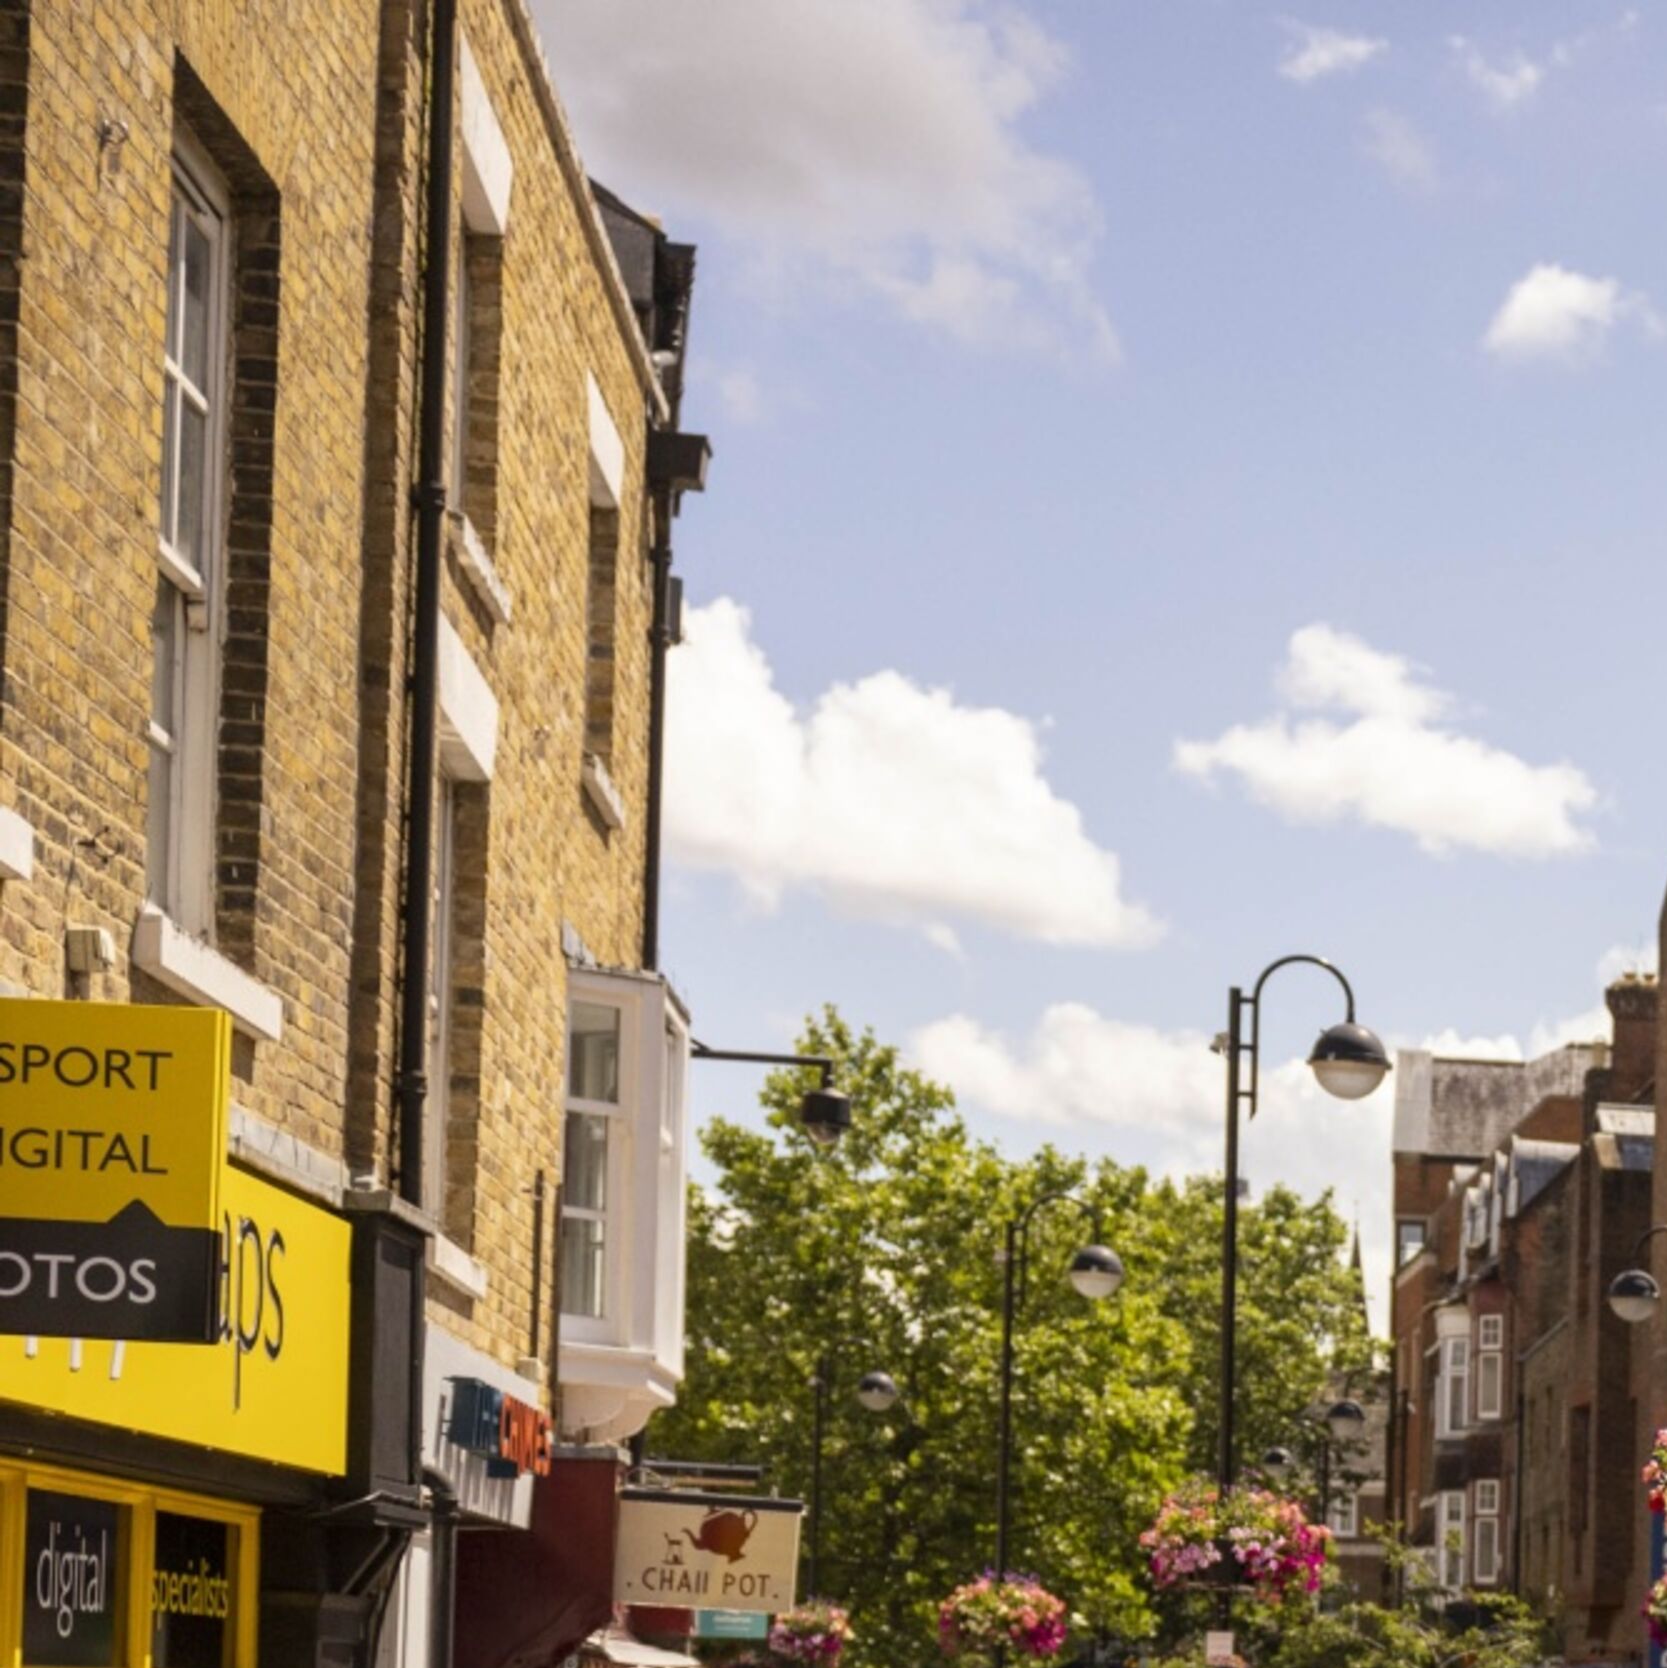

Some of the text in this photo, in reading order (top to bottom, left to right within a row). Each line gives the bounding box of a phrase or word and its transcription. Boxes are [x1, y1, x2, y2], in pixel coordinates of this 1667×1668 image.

[37, 1521, 107, 1638] digital
[152, 1557, 228, 1630] specialists
[642, 1567, 709, 1594] CHAII
